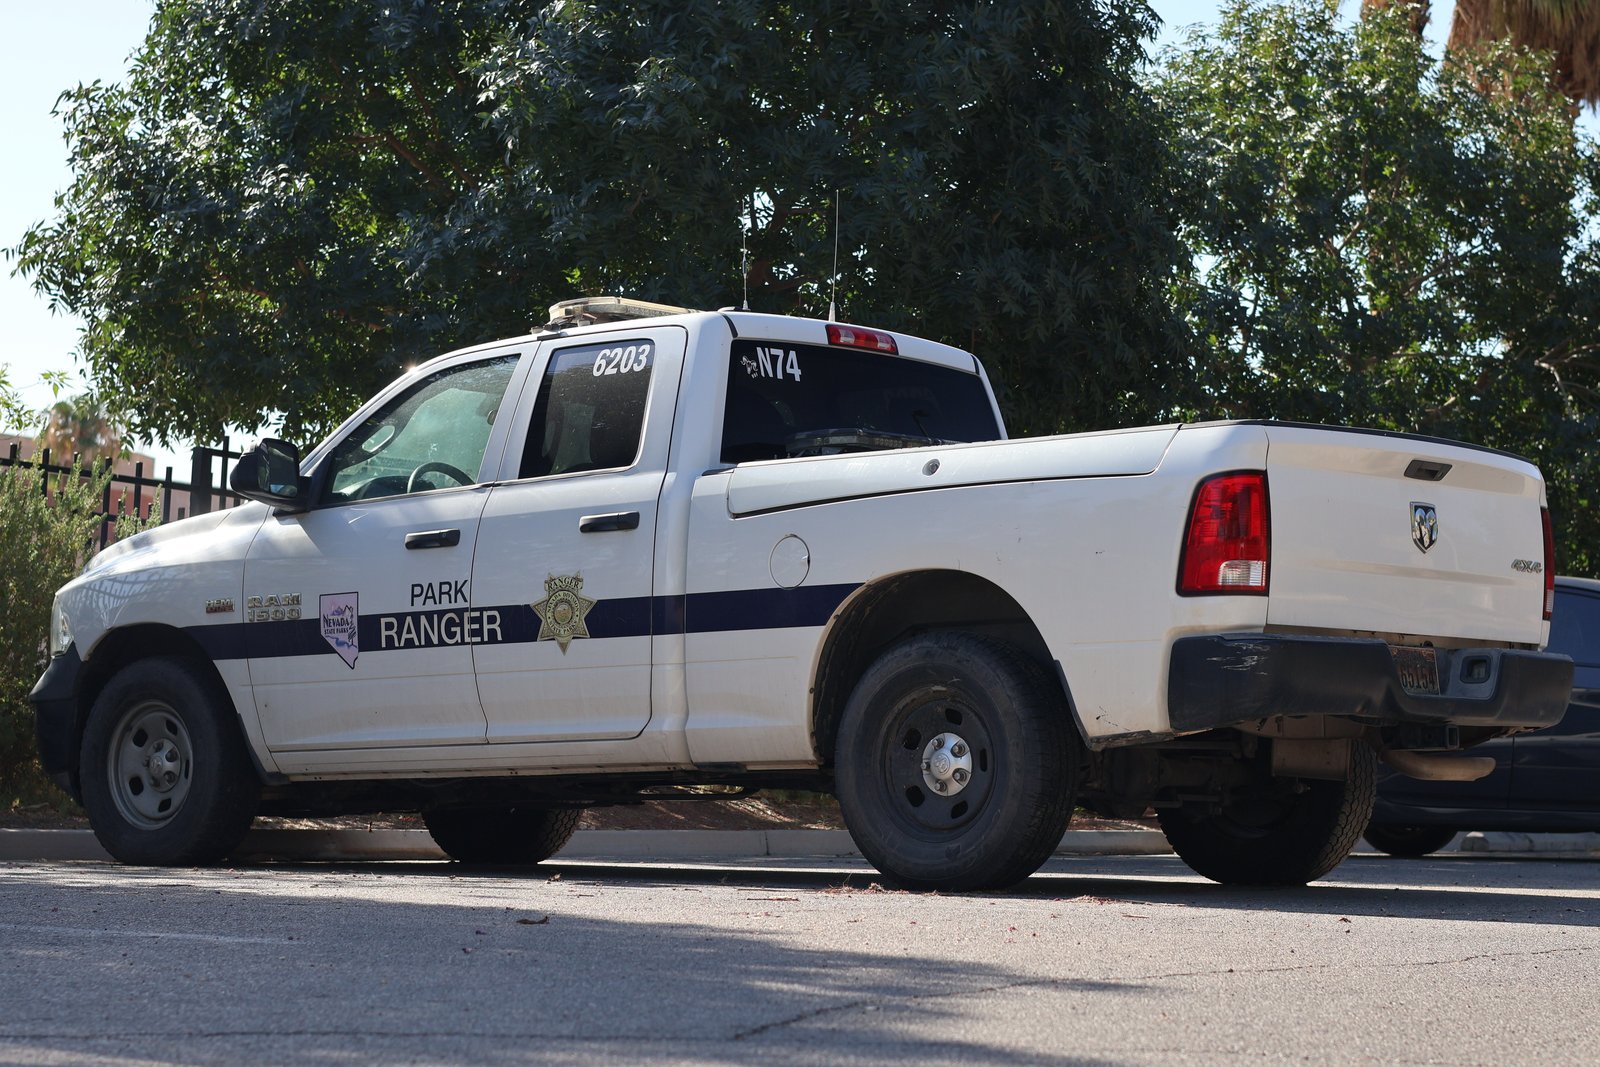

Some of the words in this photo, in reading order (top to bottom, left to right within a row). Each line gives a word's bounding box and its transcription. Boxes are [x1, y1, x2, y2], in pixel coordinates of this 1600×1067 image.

[592, 344, 651, 377] 6203
[756, 346, 802, 382] N74
[547, 576, 580, 590] RANGER
[248, 592, 302, 609] RAM
[410, 579, 469, 607] PARK
[206, 598, 234, 609] HEMI
[248, 607, 302, 622] 1500
[323, 613, 350, 629] NEVADA
[380, 610, 503, 649] RANGER
